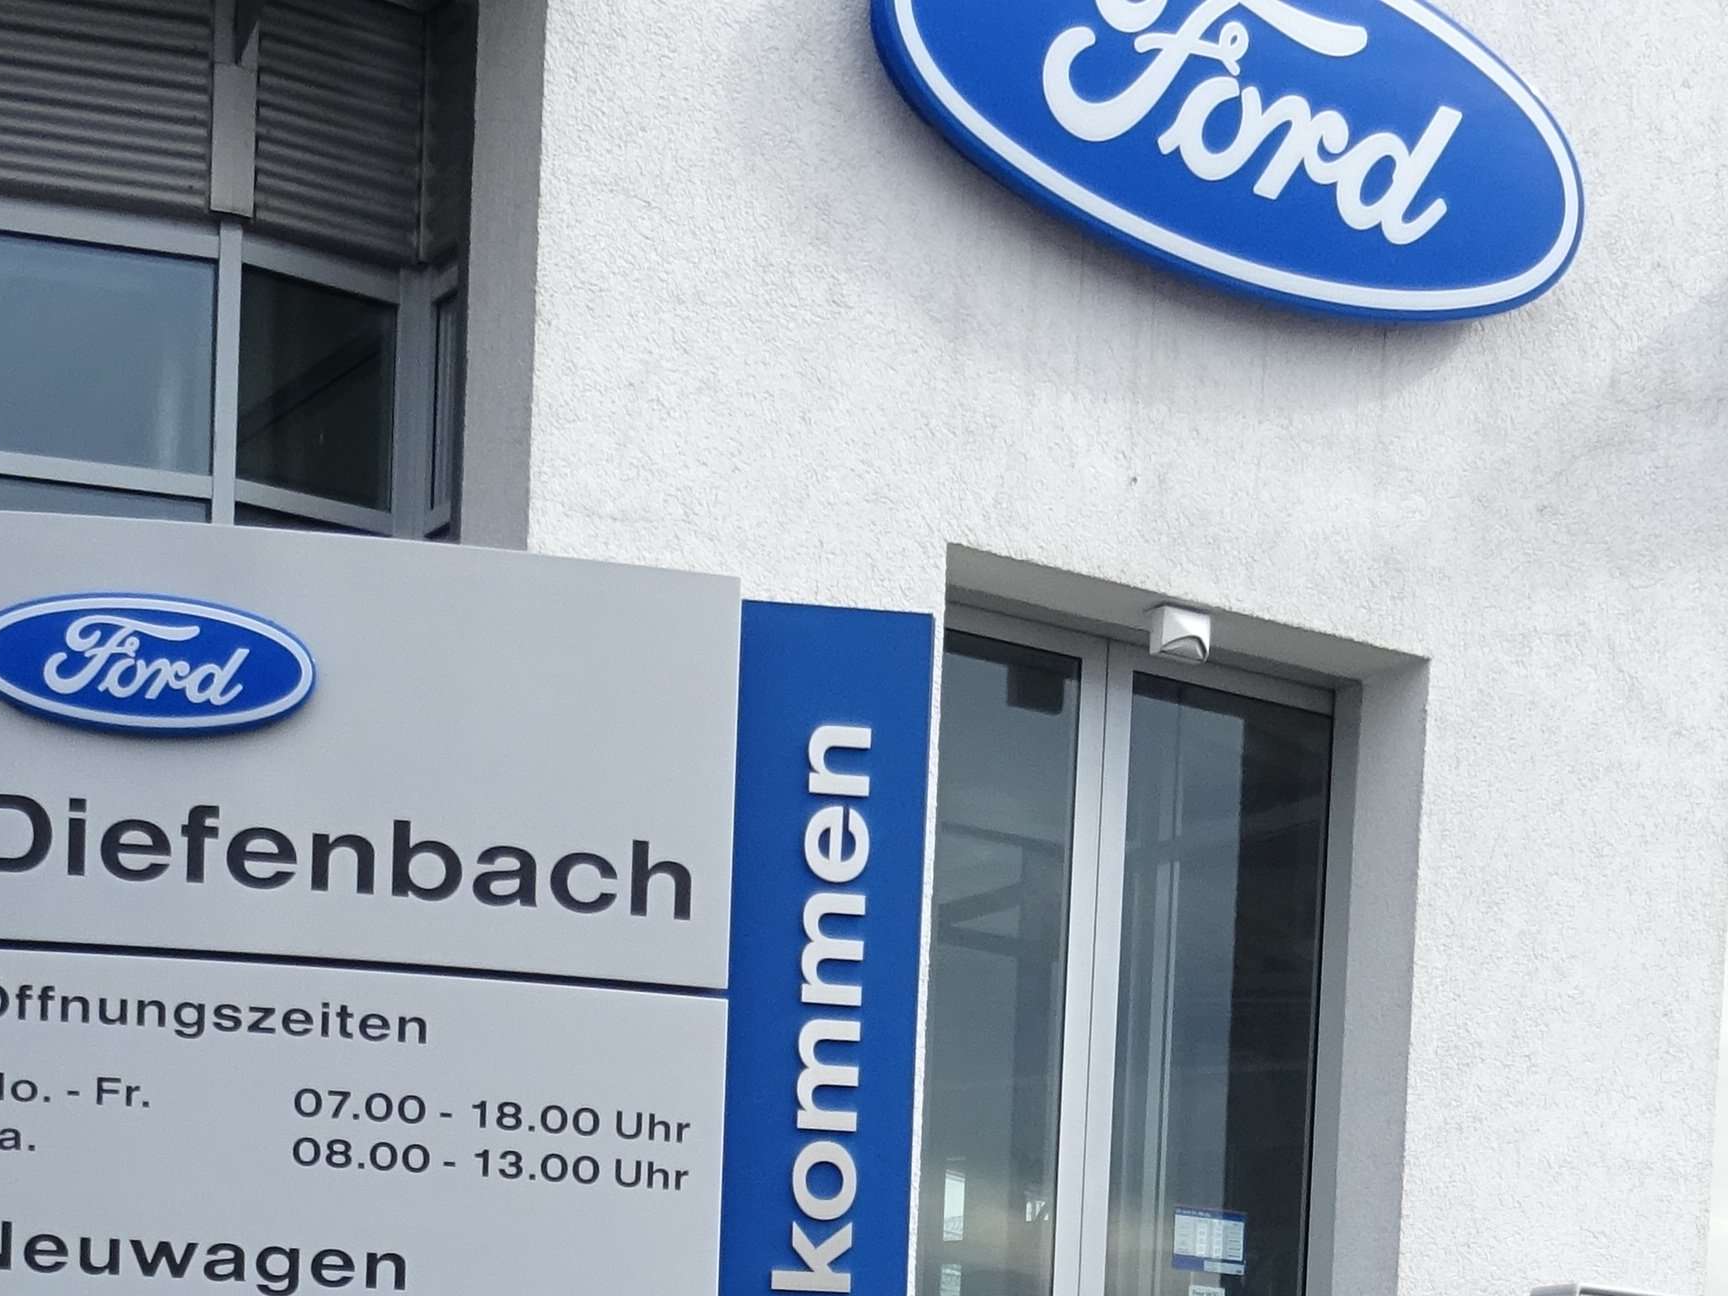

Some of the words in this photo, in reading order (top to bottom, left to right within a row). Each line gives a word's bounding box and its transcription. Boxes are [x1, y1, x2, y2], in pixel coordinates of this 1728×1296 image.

[1043, 0, 1463, 246] Ford
[44, 612, 251, 708] Ford
[95, 1076, 152, 1109] Fr.
[293, 1087, 427, 1124] 07.00
[471, 1099, 601, 1138] 18.00
[614, 1109, 692, 1144] Uhr
[291, 1136, 431, 1174] 08.00
[473, 1148, 601, 1186] 13.00
[614, 1157, 690, 1192] Uhr
